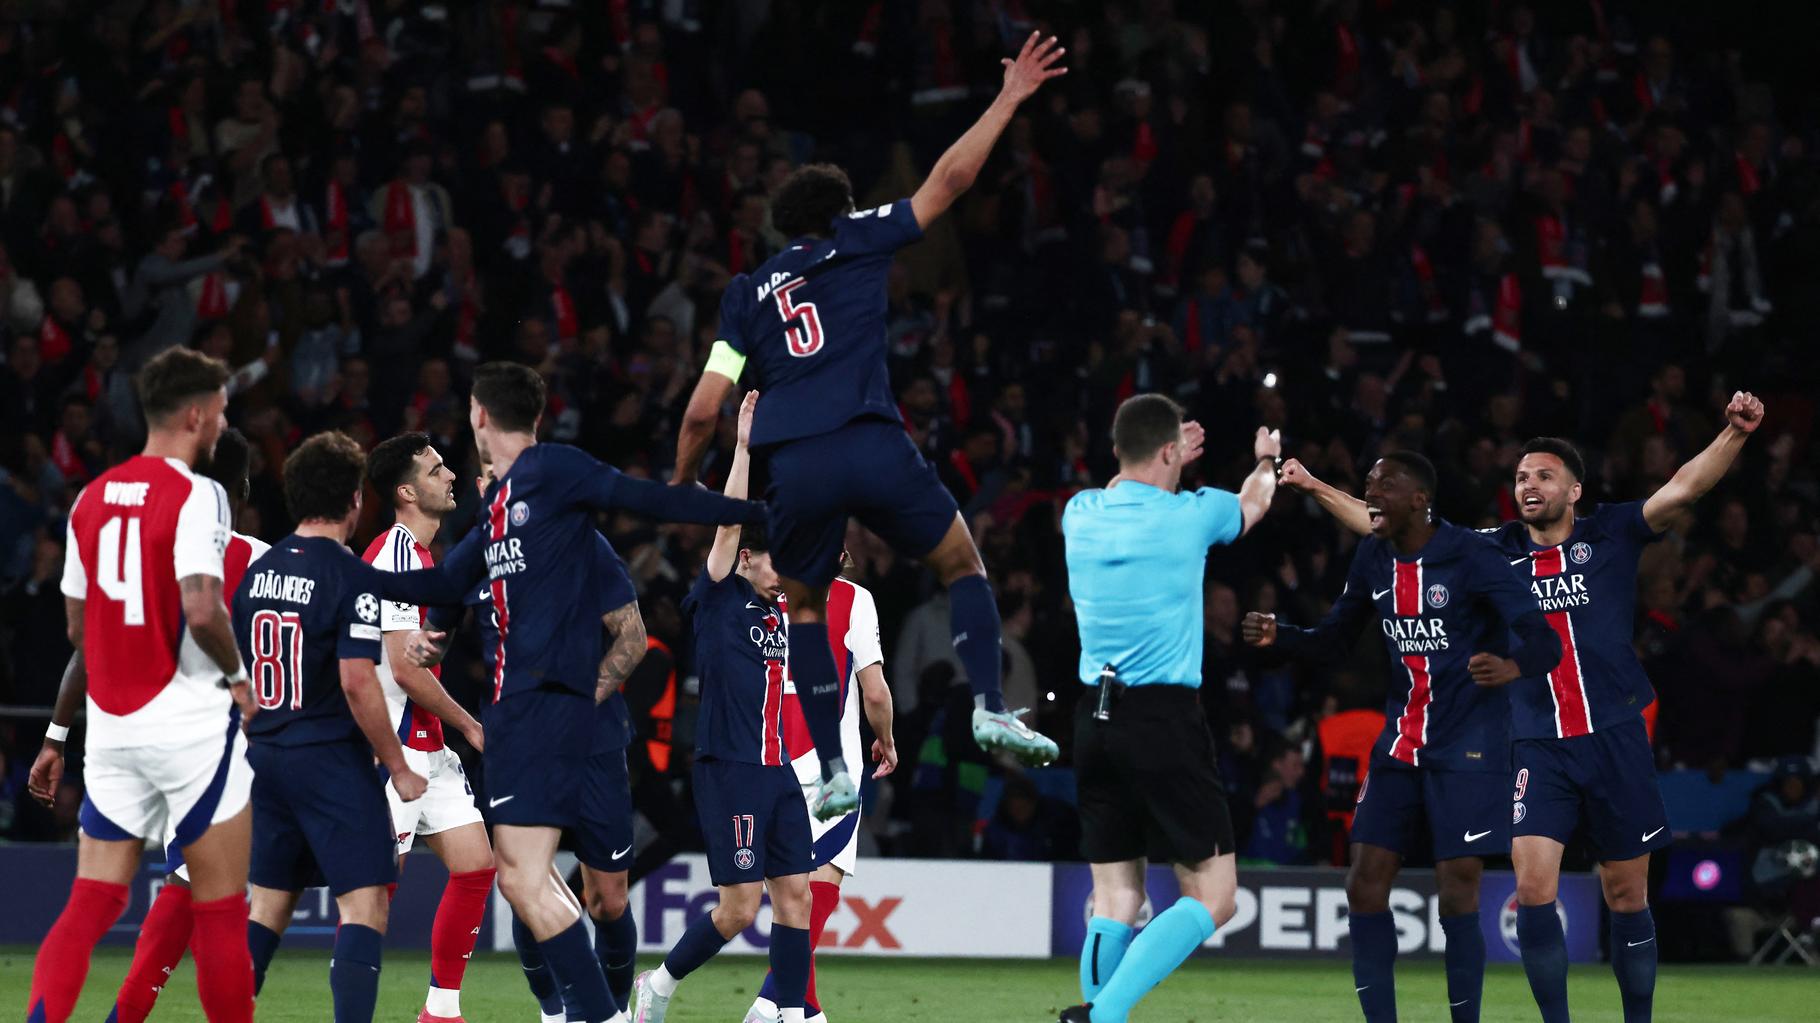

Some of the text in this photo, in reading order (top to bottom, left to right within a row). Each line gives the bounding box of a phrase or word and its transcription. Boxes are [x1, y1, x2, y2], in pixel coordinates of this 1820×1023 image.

[773, 276, 824, 357] 5
[104, 481, 150, 506] WHITE
[97, 516, 145, 625] 4
[484, 537, 524, 572] ATAR
[1531, 574, 1587, 599] ATAR
[1538, 592, 1590, 611] IRWAYS
[1382, 618, 1447, 642] QATAR
[251, 609, 303, 710] 87
[1513, 768, 1529, 802] 9
[731, 814, 754, 849] 17
